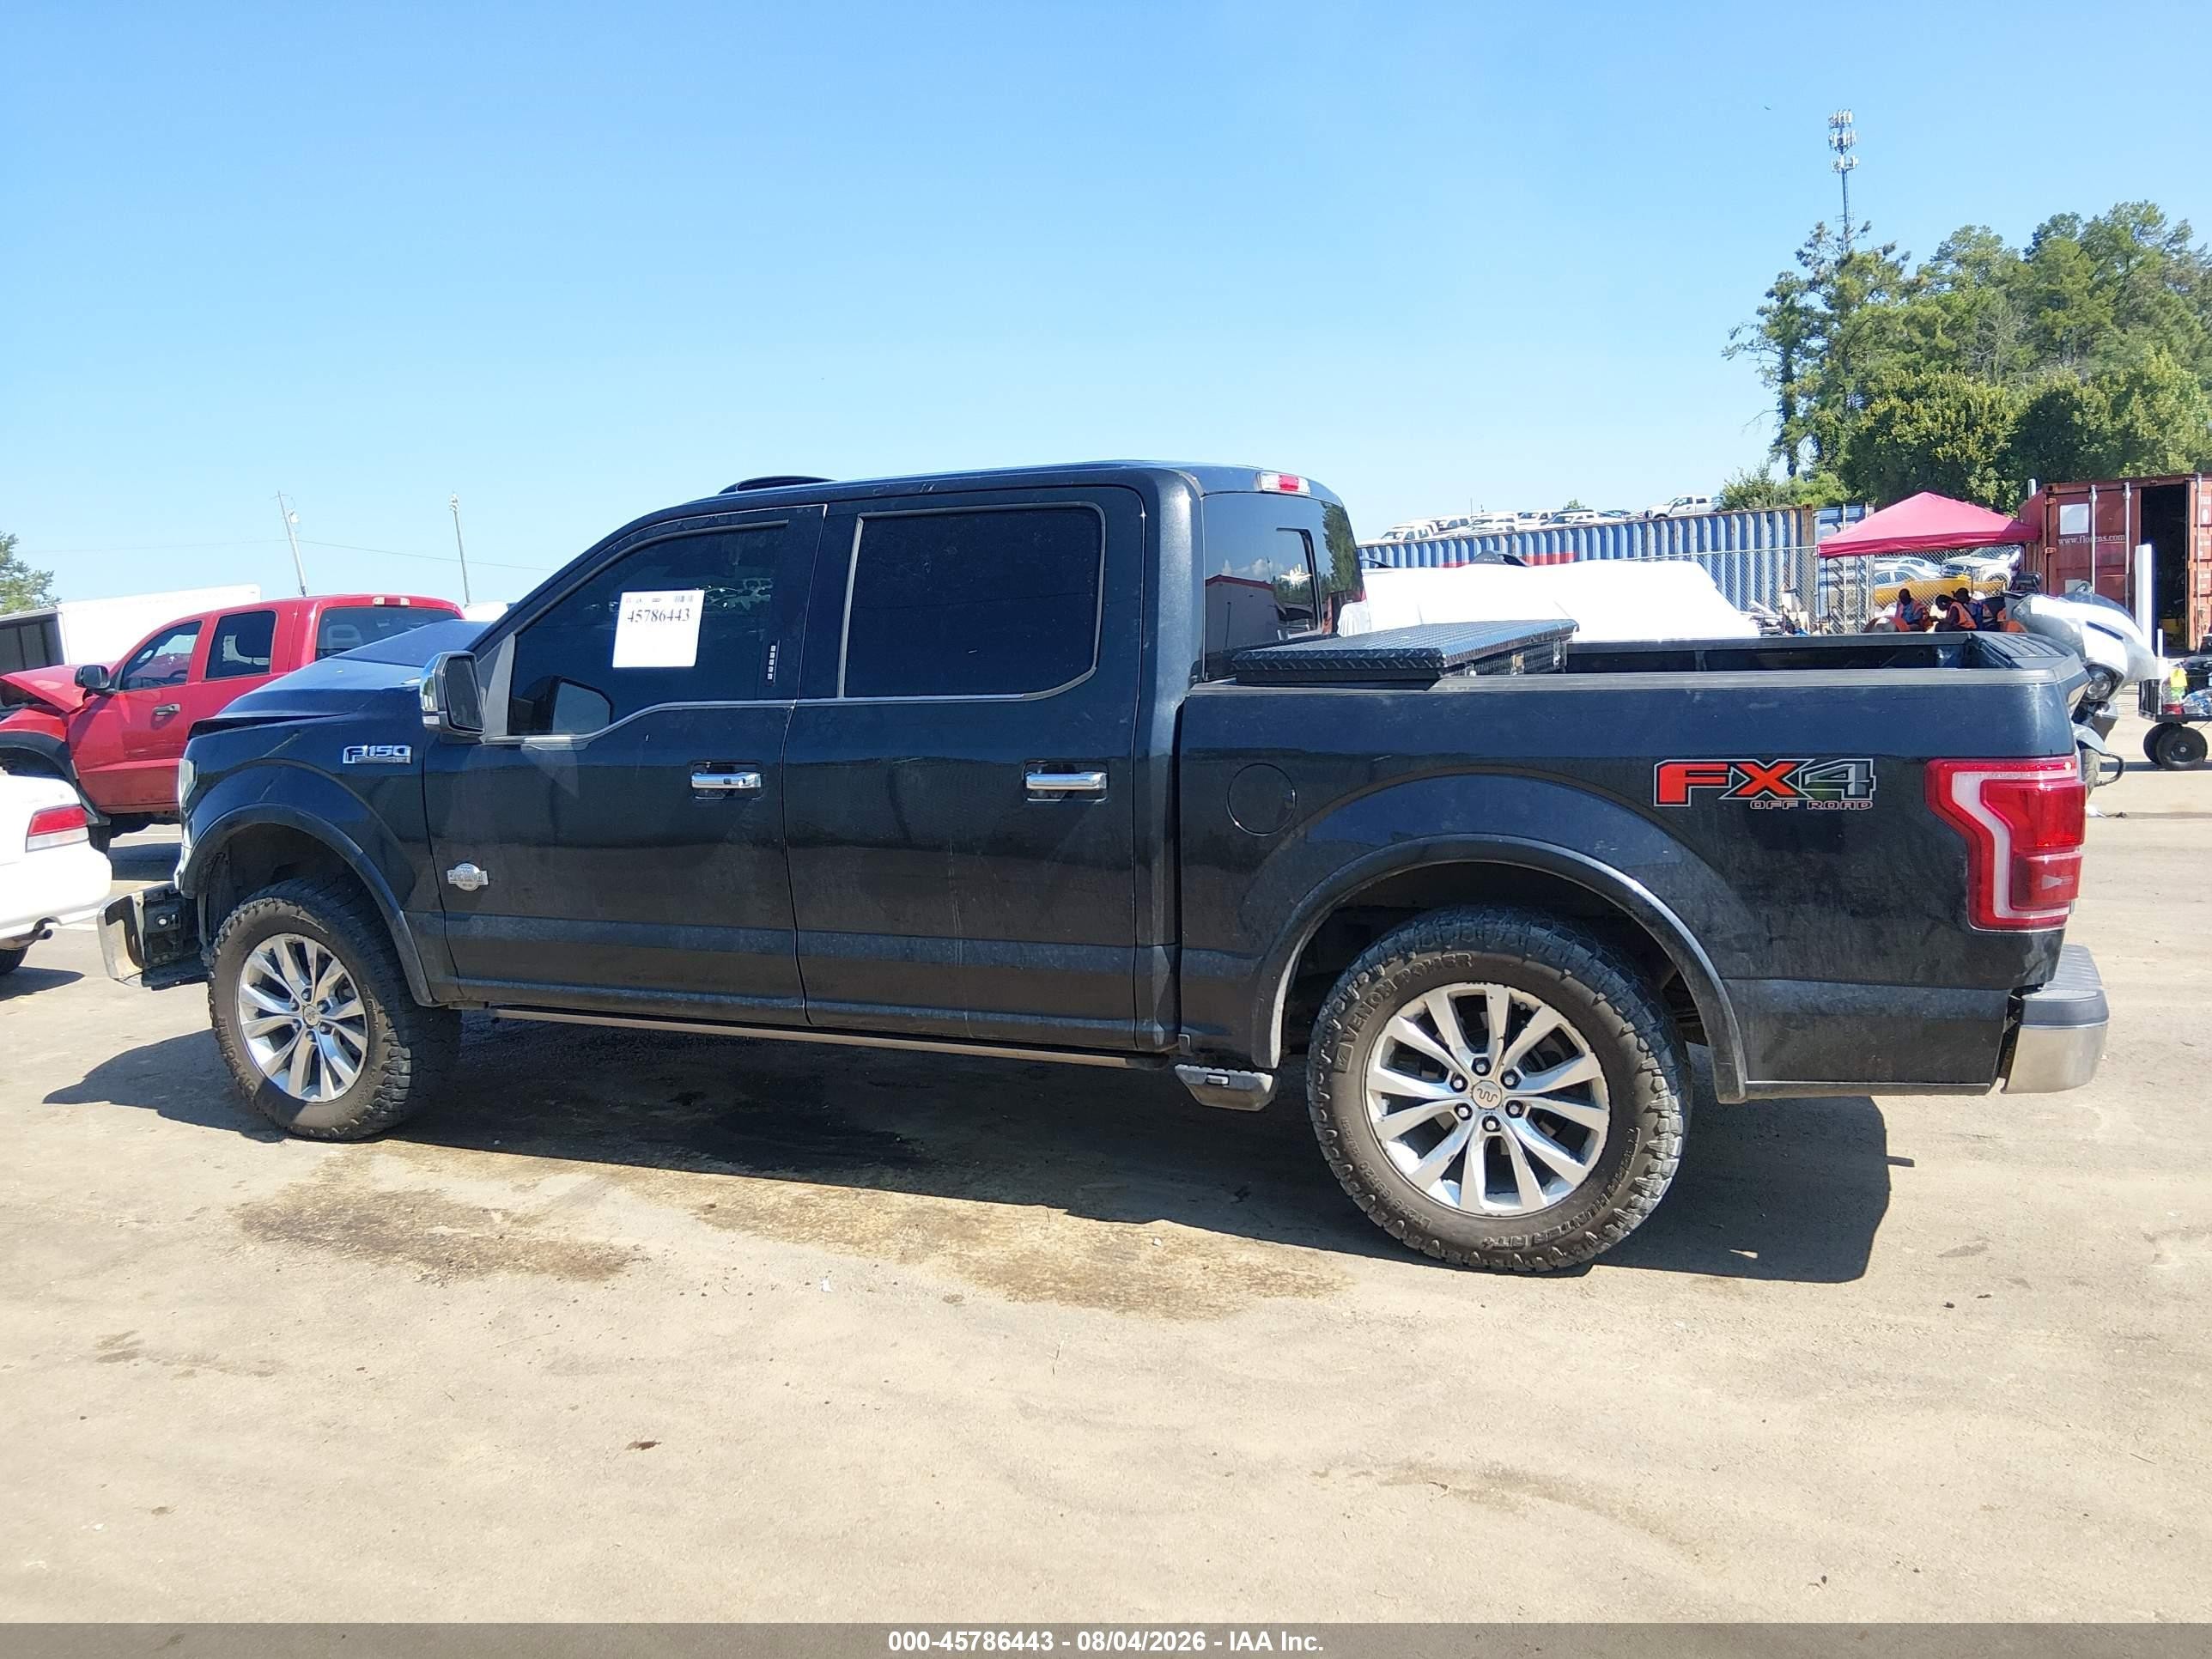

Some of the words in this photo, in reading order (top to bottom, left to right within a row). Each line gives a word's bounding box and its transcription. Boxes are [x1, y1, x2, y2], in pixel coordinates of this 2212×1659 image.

[627, 607, 690, 623] 45786443
[1654, 759, 1877, 806] FX4
[1749, 800, 1799, 811] OFF
[1807, 800, 1874, 811] ROAD
[1340, 977, 1398, 1044] VENOM
[1393, 952, 1474, 984] POWER
